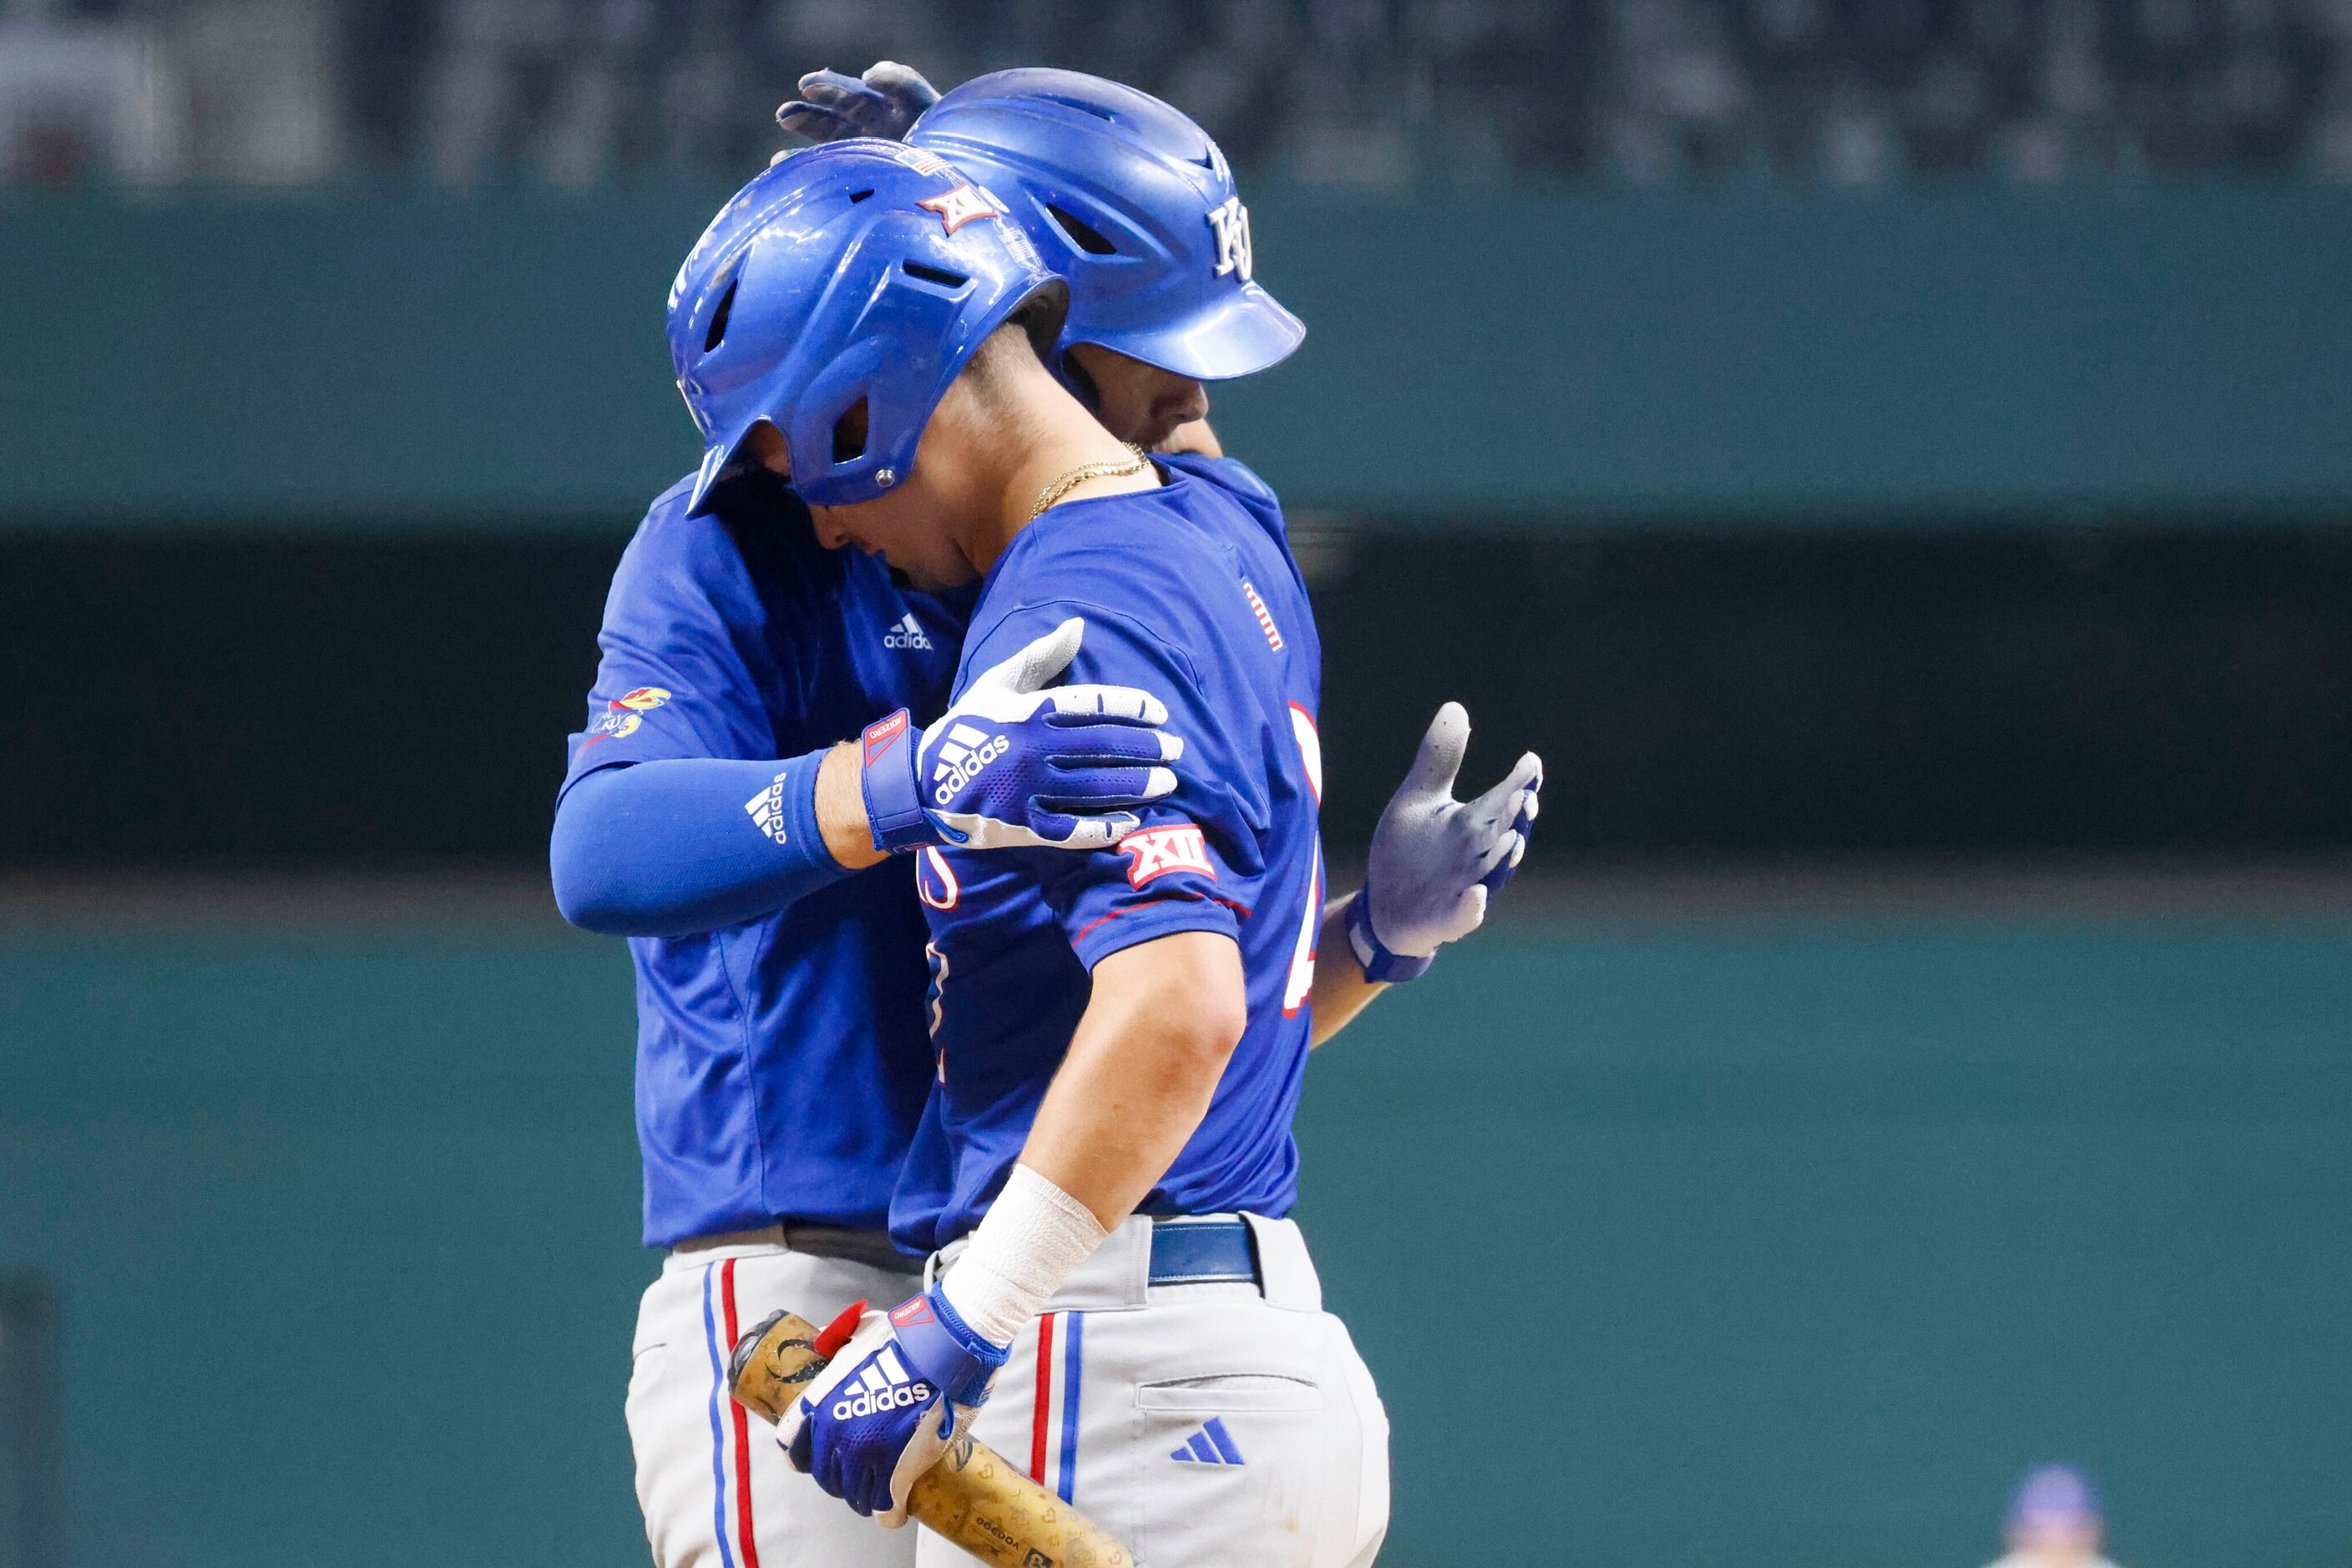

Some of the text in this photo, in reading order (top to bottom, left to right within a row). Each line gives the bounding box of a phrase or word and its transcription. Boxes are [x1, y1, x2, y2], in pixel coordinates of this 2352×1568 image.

[1207, 195, 1252, 281] KU
[600, 713, 621, 731] KU
[869, 715, 903, 739] ADIZERO
[935, 734, 1009, 805] adidas
[766, 771, 787, 845] adidas
[1120, 828, 1216, 884] XII
[832, 1383, 931, 1421] adidas
[975, 1516, 1020, 1551] VOODOO
